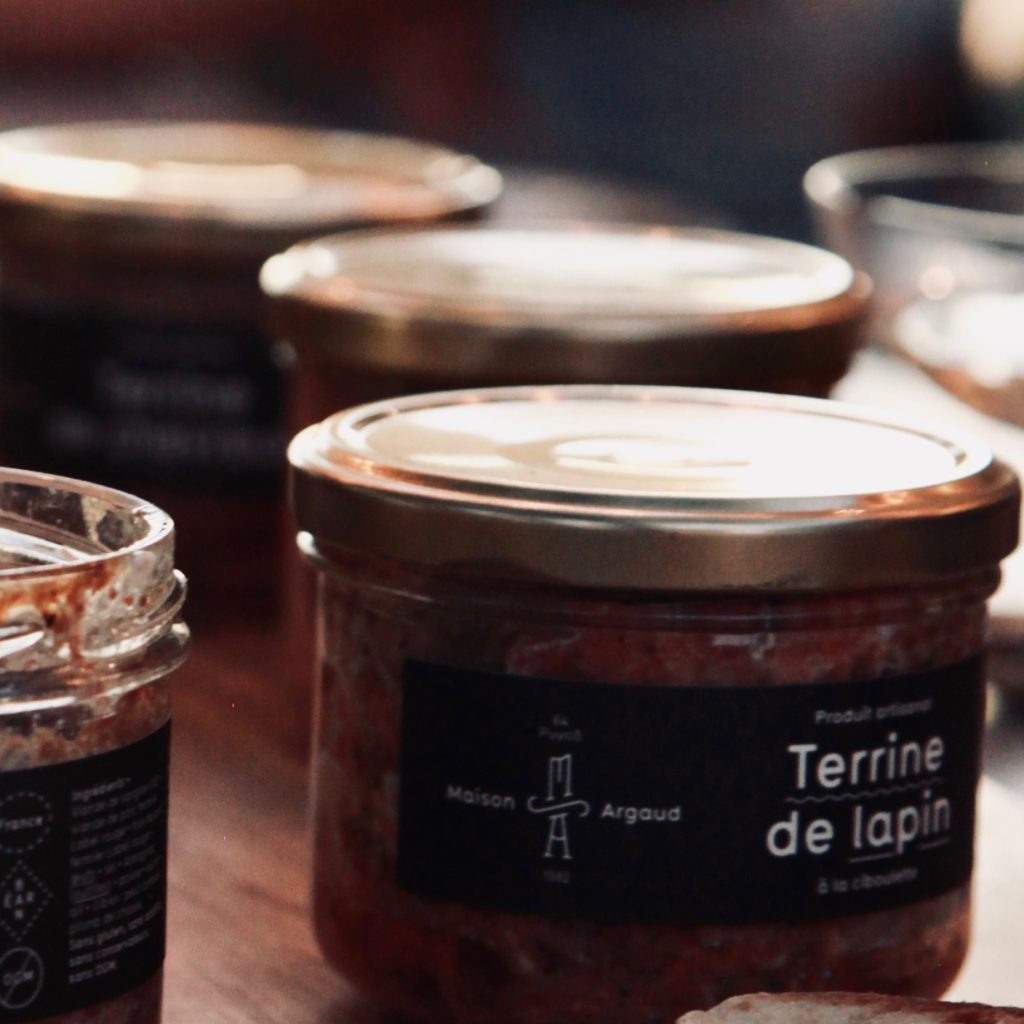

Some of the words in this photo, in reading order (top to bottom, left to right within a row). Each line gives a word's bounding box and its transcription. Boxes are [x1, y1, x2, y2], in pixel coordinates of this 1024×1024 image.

[815, 705, 872, 724] Produit
[787, 732, 944, 790] Terrine
[446, 785, 516, 810] Maison
[600, 803, 681, 826] Argaud
[766, 810, 834, 856] de
[851, 789, 952, 855] lapin
